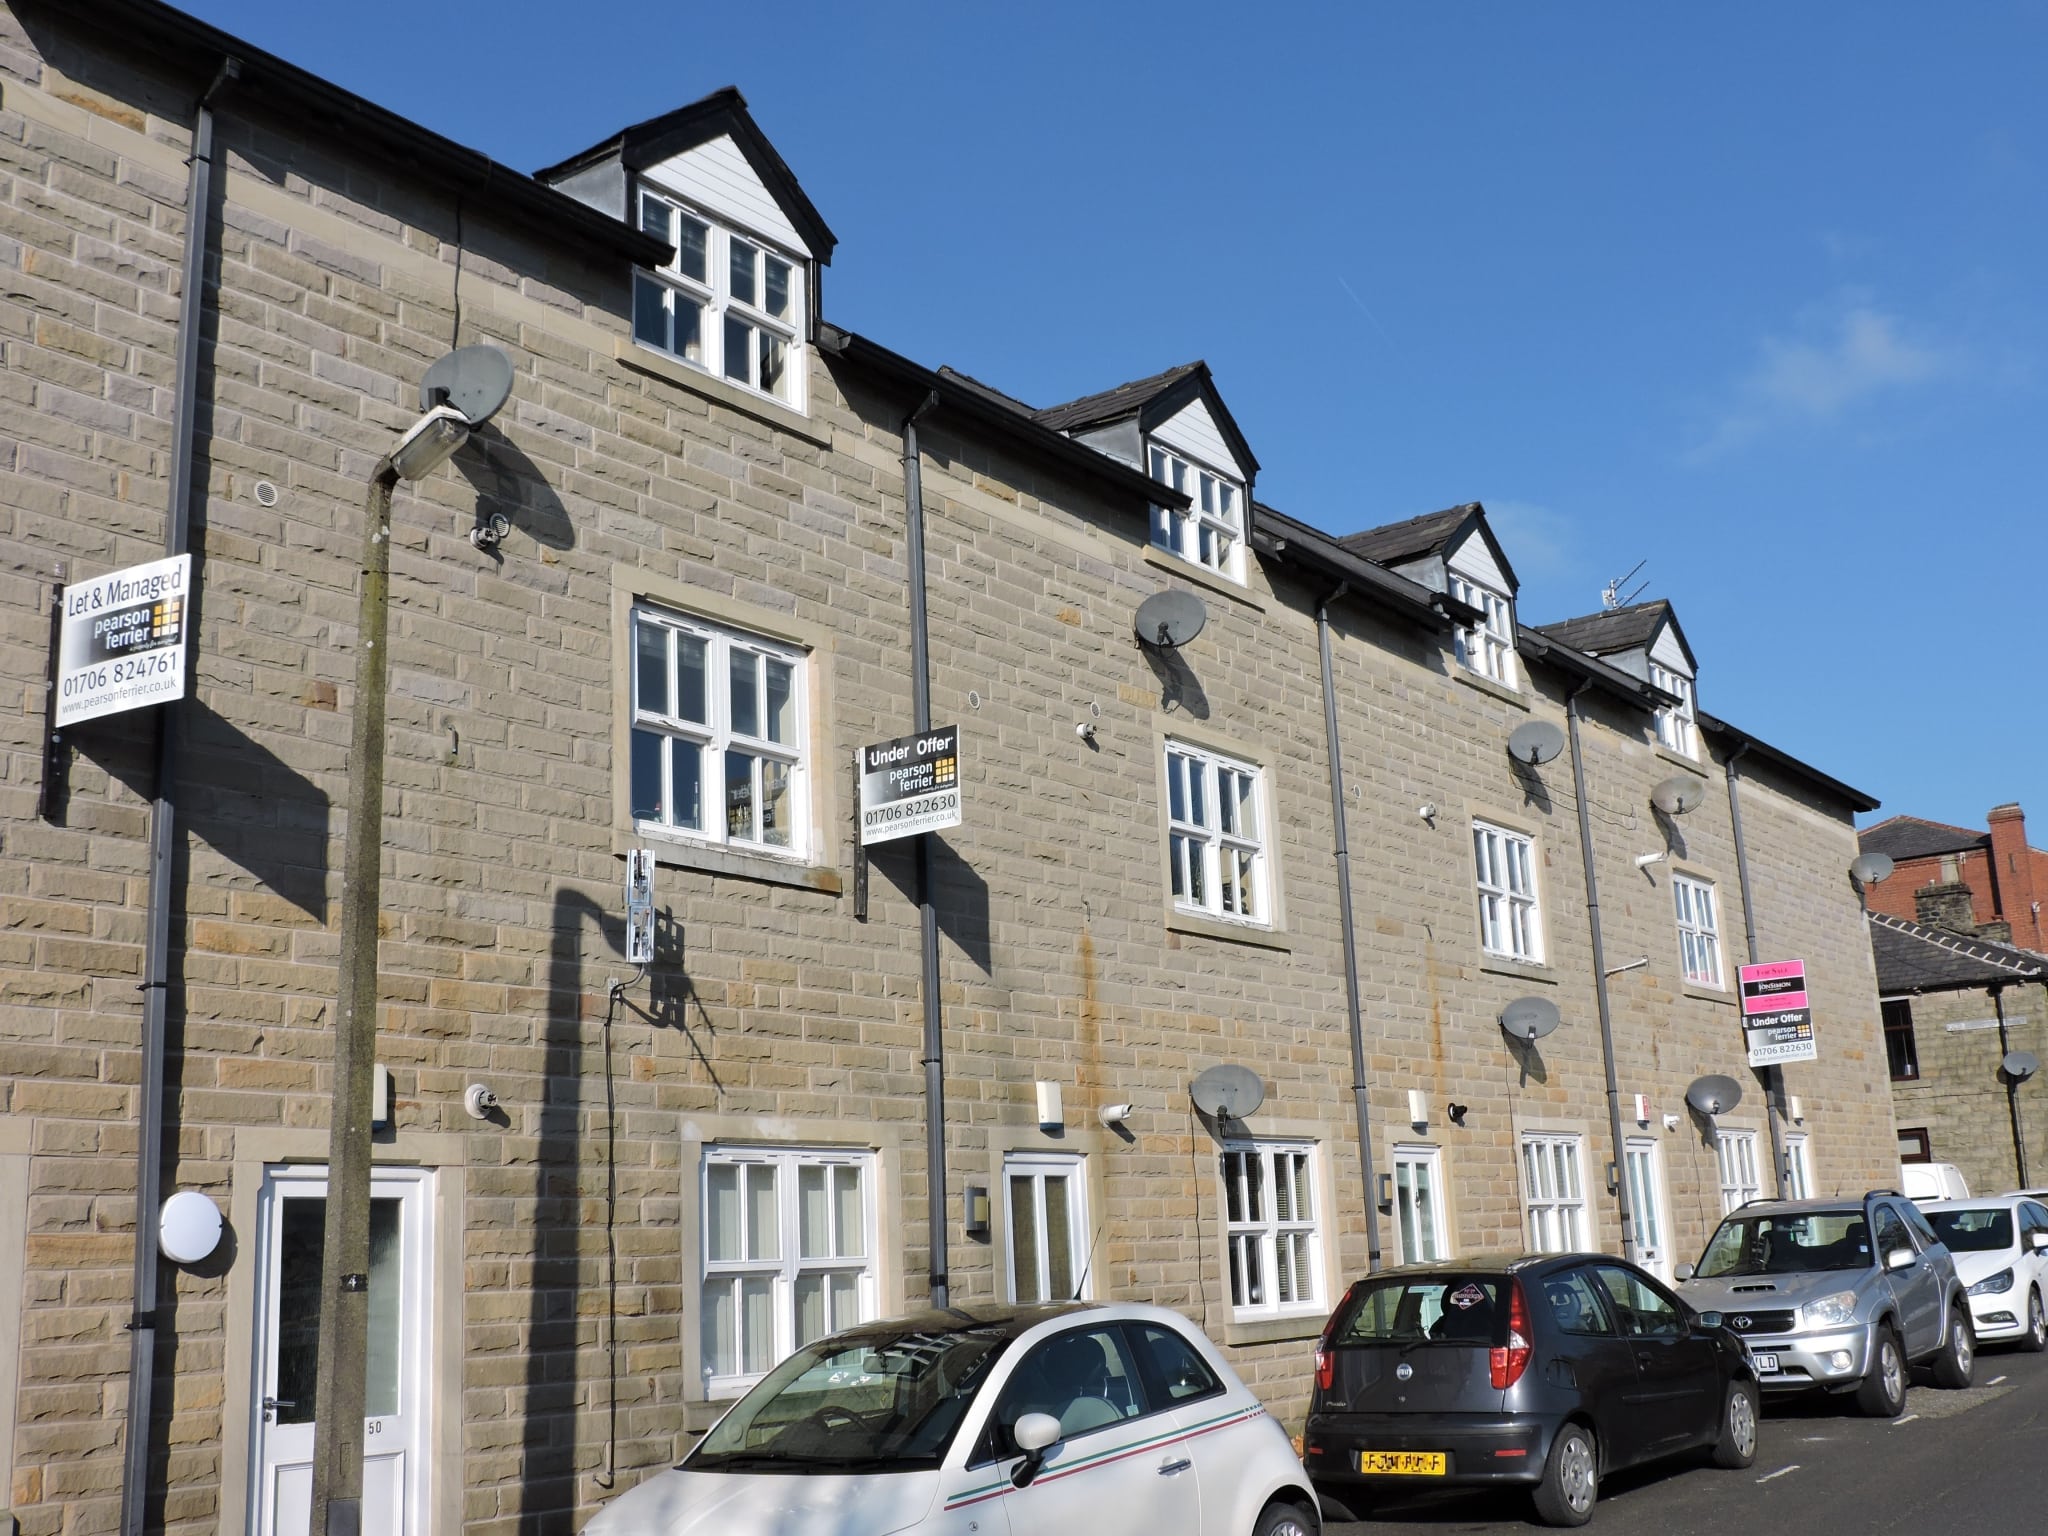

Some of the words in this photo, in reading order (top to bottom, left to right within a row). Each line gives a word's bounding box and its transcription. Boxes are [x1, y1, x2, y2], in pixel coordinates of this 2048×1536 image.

[69, 592, 88, 617] Let
[91, 587, 103, 610] &
[106, 564, 182, 607] Managed
[94, 609, 150, 639] pearson
[105, 626, 149, 650] ferrier
[64, 667, 107, 697] 01706
[114, 651, 177, 683] 824761
[62, 677, 177, 714] www.pearsonferrier.co.uk
[870, 746, 910, 767] Under
[916, 736, 951, 755] Offer
[890, 763, 933, 784] pearson
[900, 775, 934, 792] ferrier
[866, 805, 902, 825] 01706
[906, 794, 956, 816] 822630
[866, 810, 956, 836] www.pearsonferrier.co.uk
[1752, 1016, 1779, 1027] Under
[1780, 1013, 1803, 1023] Offer
[1767, 1026, 1797, 1036] pearson
[1775, 1032, 1798, 1041] ferrier
[1753, 1046, 1778, 1056] 01706
[1780, 1042, 1812, 1053] 822630
[348, 1275, 357, 1290] 4
[368, 1421, 382, 1434] 50
